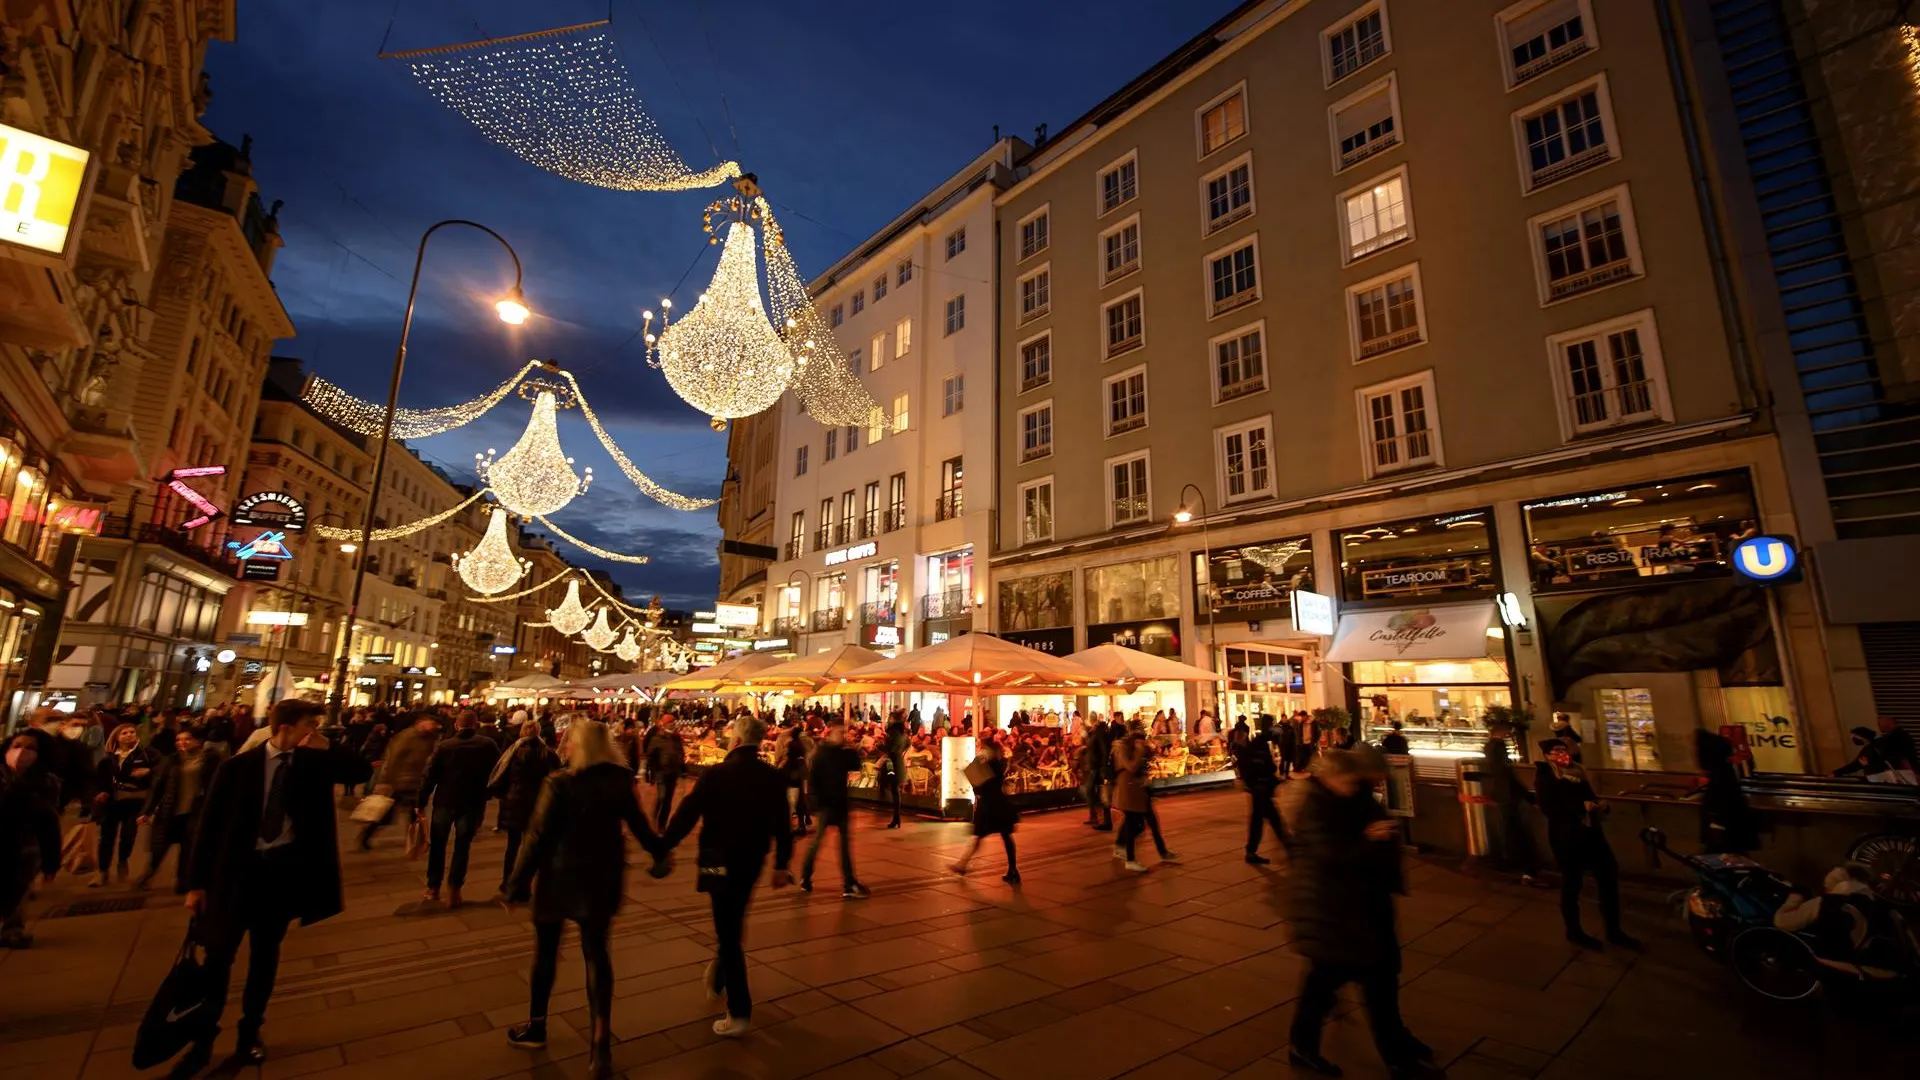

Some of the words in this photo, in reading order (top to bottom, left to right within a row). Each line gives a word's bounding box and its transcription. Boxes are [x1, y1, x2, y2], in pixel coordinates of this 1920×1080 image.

[248, 511, 292, 522] BUFFET
[1741, 542, 1787, 576] U
[1386, 570, 1446, 585] TEAROOM
[1236, 588, 1272, 600] COFFEE
[1112, 632, 1154, 646] Jones
